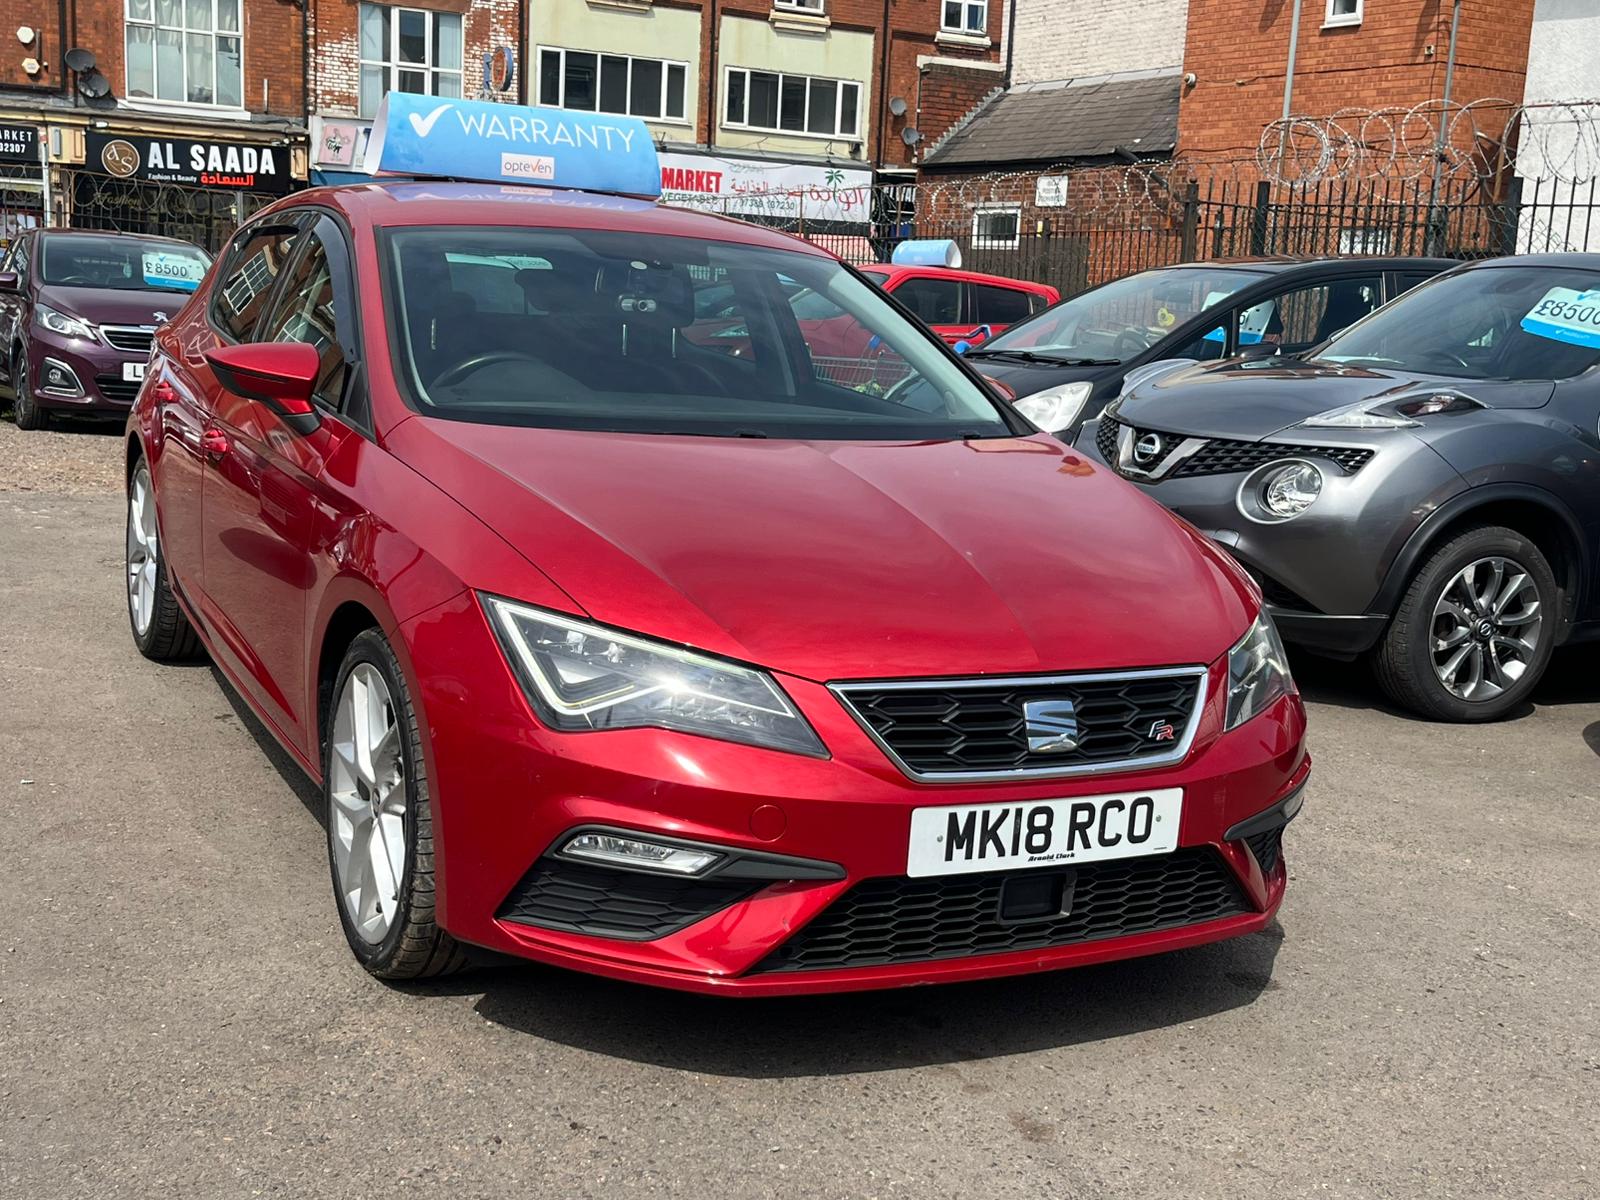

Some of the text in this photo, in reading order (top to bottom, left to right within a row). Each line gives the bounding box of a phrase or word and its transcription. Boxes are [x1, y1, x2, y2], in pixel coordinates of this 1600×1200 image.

[455, 110, 635, 153] WARRANTY
[148, 142, 276, 175] AL SAADA
[504, 159, 552, 174] opteven
[177, 174, 197, 183] Beauty
[201, 172, 254, 186] السعادة
[661, 167, 722, 193] MARKET
[145, 261, 187, 277] £8500
[133, 365, 147, 378] L
[1148, 719, 1175, 741] FR
[944, 796, 1154, 862] MK18 RCO
[1028, 852, 1075, 862] Arnold Clark
